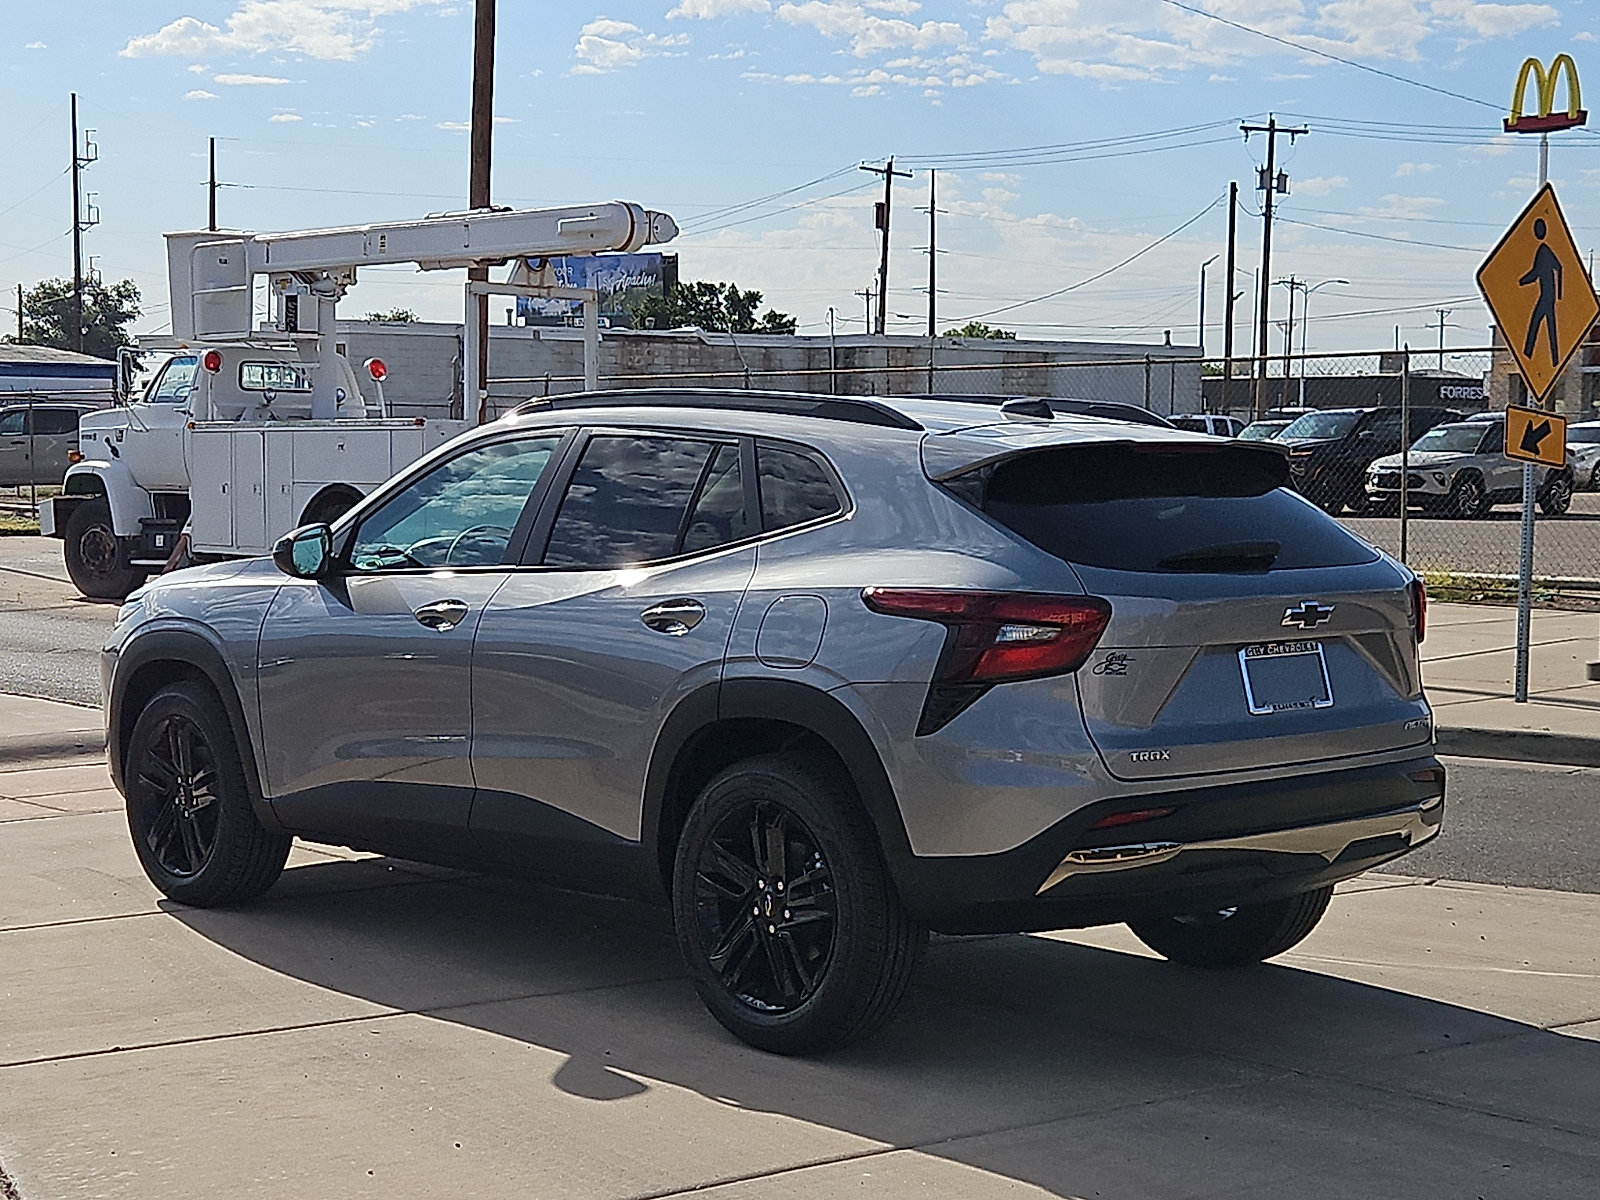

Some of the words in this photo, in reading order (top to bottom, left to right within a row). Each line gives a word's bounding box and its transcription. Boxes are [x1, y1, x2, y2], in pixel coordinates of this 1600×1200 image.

[1440, 386, 1484, 399] FORRES
[1267, 642, 1317, 654] CHEVROLET
[1129, 750, 1170, 762] TRAX
